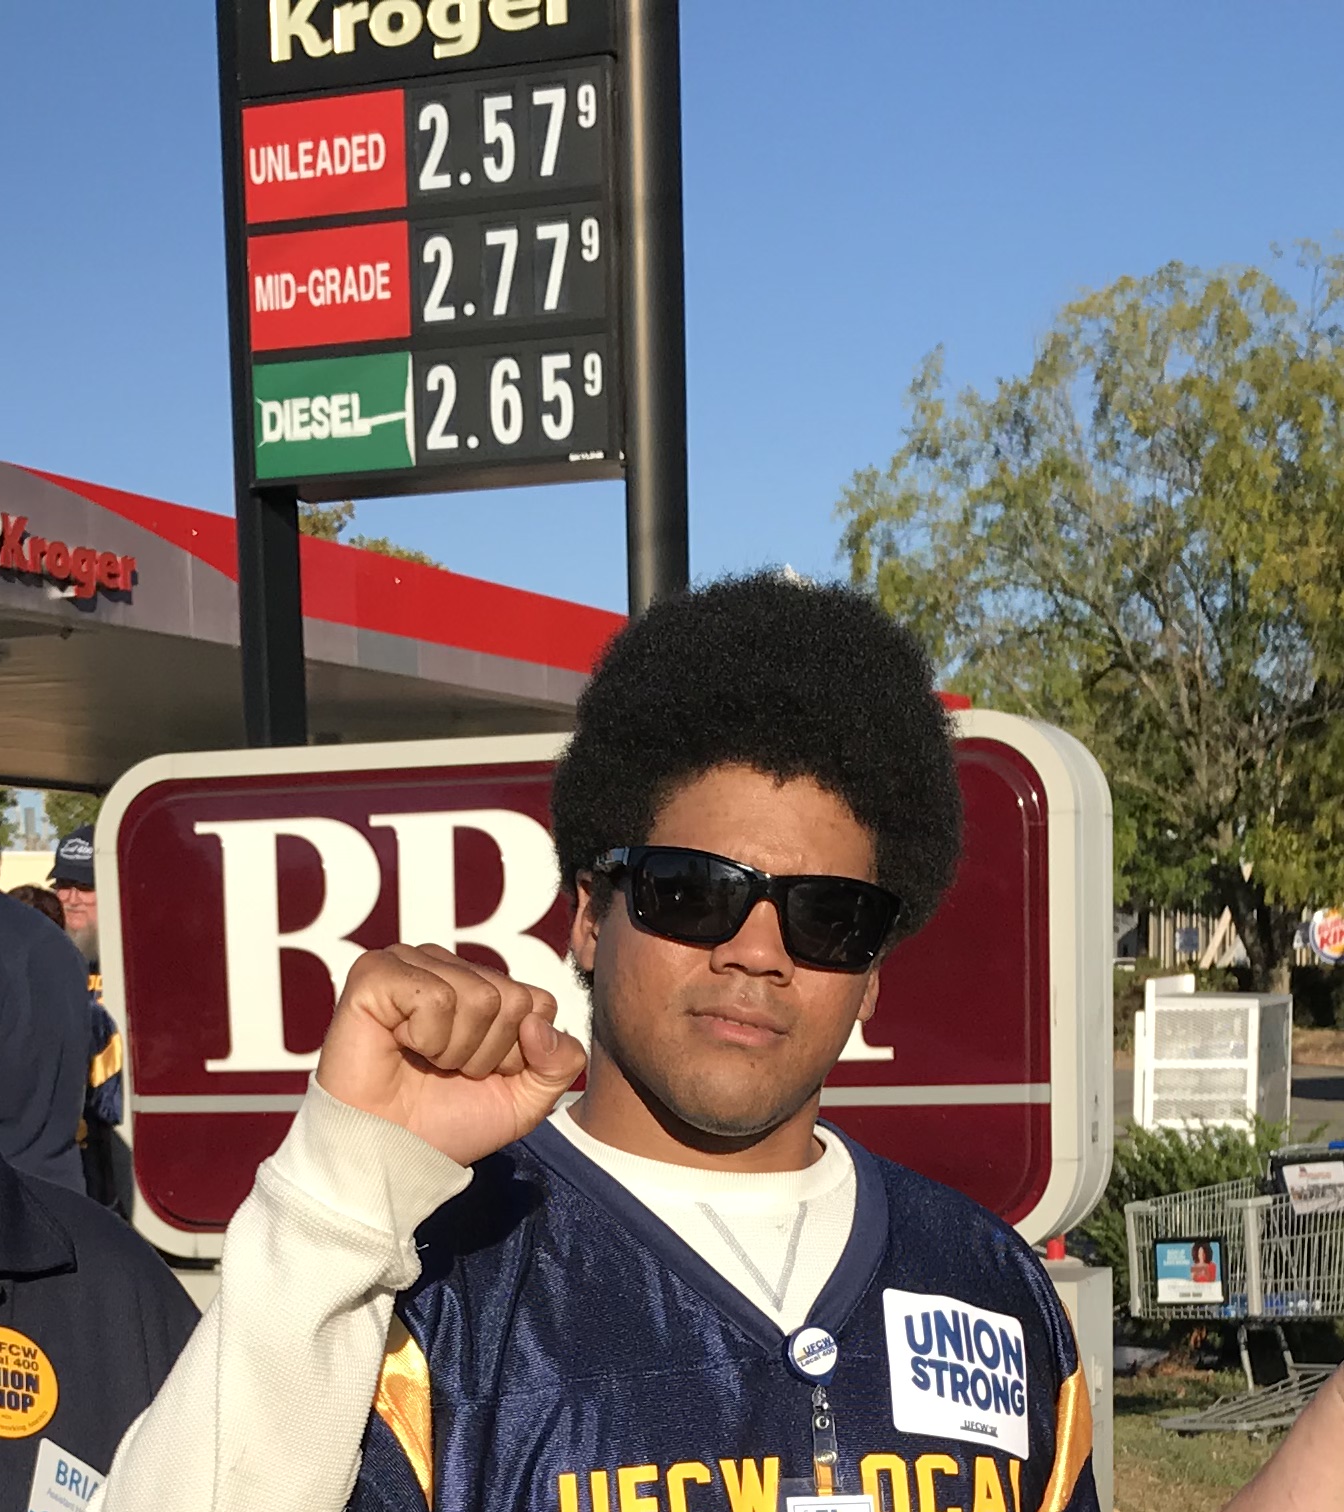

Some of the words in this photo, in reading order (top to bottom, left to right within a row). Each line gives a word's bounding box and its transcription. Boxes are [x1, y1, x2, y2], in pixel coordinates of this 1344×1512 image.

[249, 133, 387, 185] UNLEADED
[254, 262, 391, 313] MID-GRADE
[260, 392, 372, 443] DIESEL
[13, 1358, 40, 1372] 400
[800, 1353, 821, 1368] Local
[802, 1335, 832, 1358] UFCW
[904, 1309, 1025, 1380] UNION
[910, 1355, 1026, 1417] STRONG
